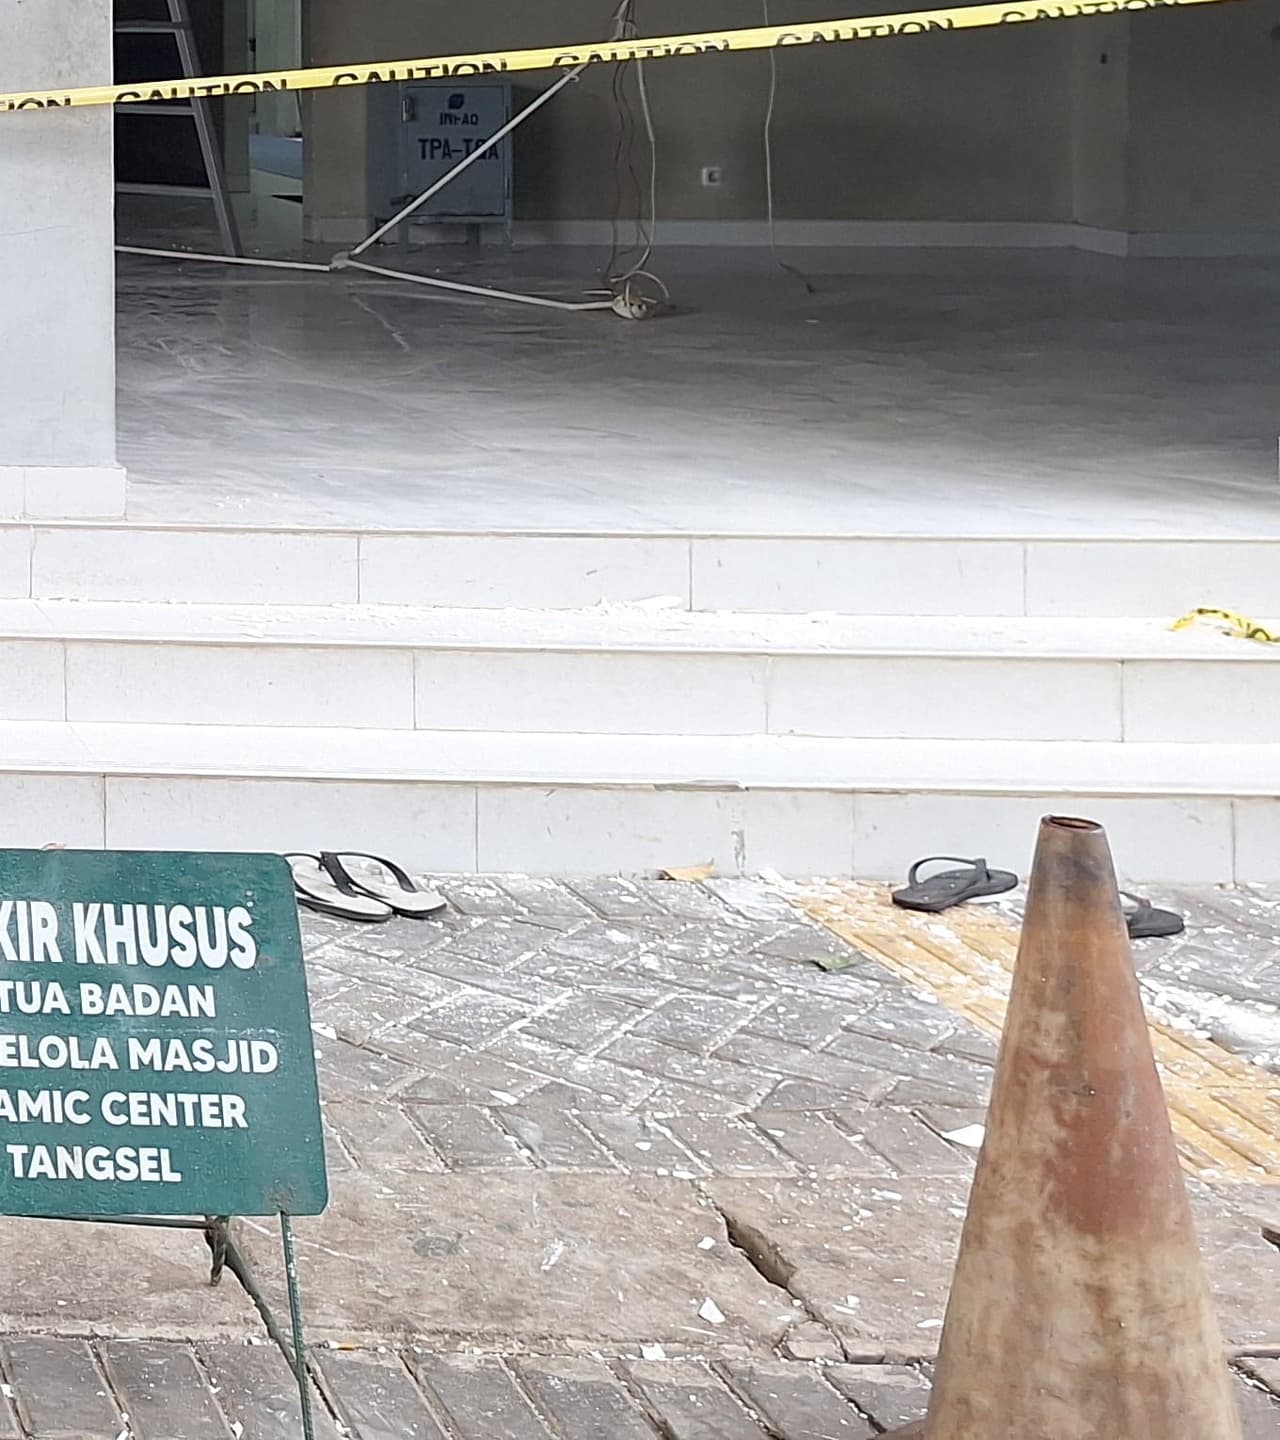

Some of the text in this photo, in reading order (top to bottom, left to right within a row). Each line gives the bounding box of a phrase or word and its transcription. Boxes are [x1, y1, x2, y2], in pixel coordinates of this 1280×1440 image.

[72, 901, 258, 970] KHUSUS
[80, 983, 216, 1018] BADAN
[128, 1038, 279, 1074] MASJID
[101, 1091, 249, 1129] CENTER
[6, 1144, 182, 1183] TANGSEL
